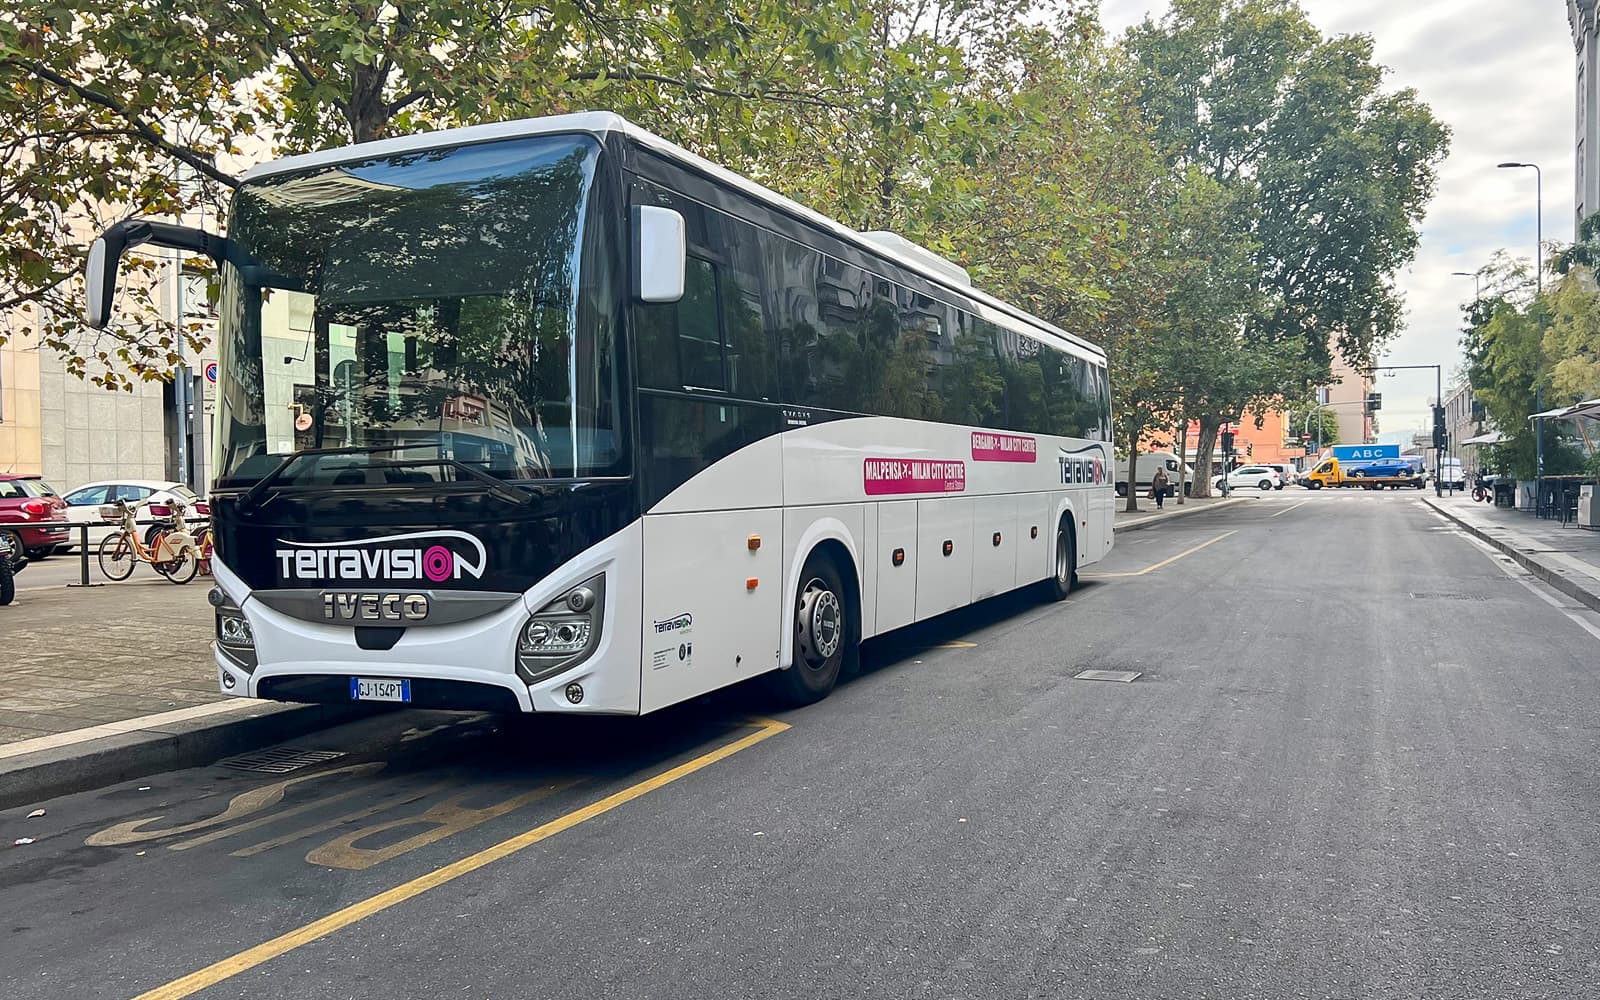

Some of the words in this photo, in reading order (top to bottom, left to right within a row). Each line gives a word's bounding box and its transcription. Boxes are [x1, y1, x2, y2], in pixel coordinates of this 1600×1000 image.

[972, 434, 994, 450] BERGAMO
[1000, 436, 1013, 451] MILAN
[1013, 438, 1021, 452] CITY
[1022, 439, 1036, 453] CENTRE
[1352, 449, 1383, 458] ABC
[865, 461, 903, 481] MALPENSA
[912, 462, 931, 480] MILAN
[931, 463, 944, 480] CITY
[944, 463, 964, 480] CENTRE
[323, 592, 429, 620] IVECO
